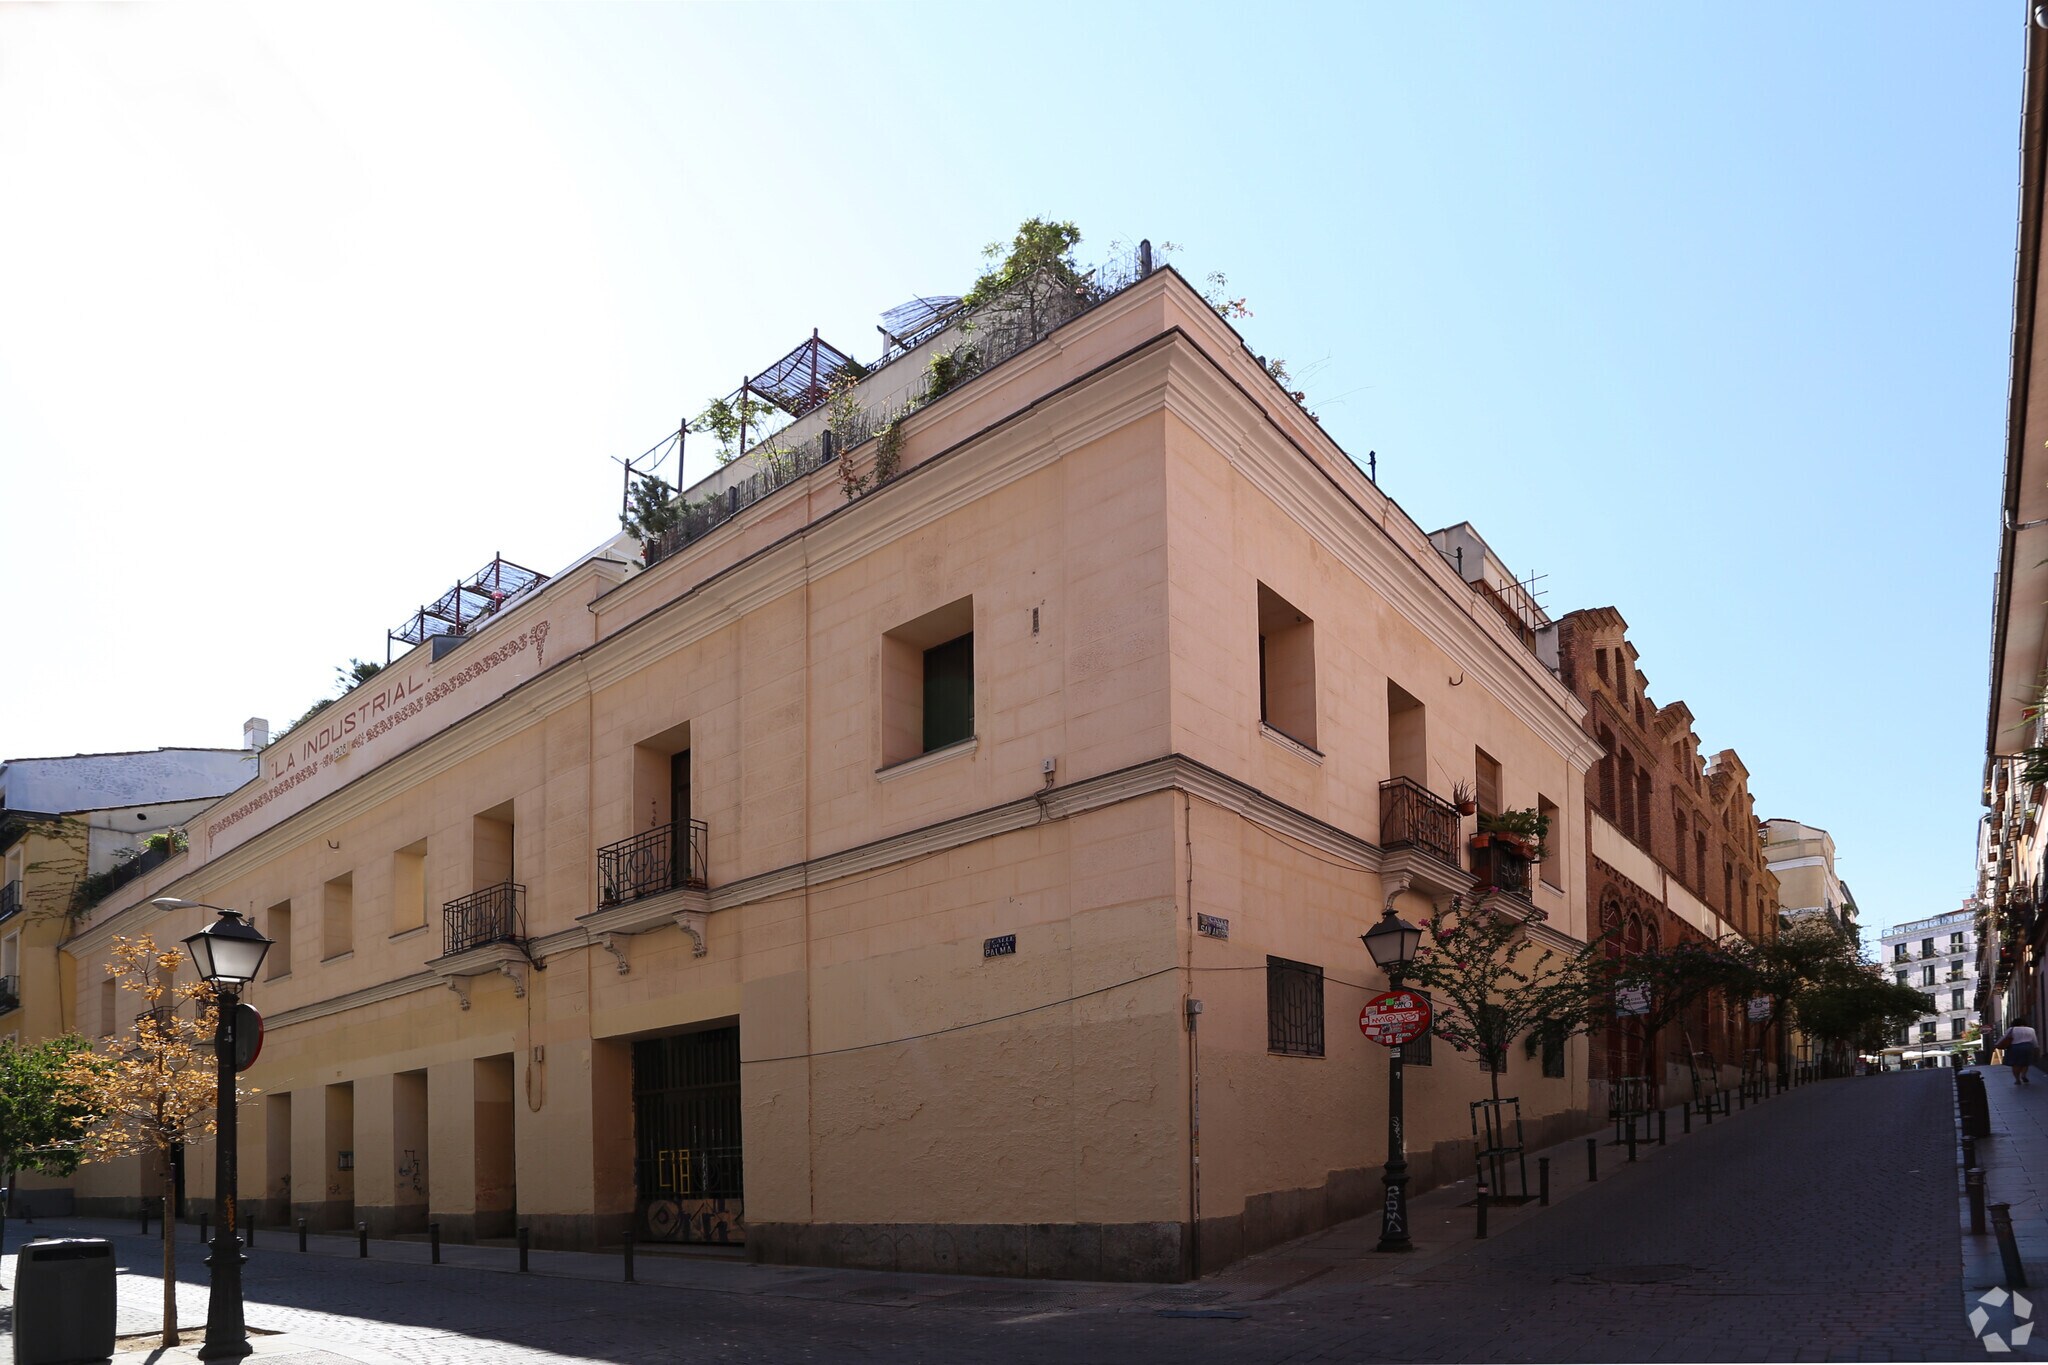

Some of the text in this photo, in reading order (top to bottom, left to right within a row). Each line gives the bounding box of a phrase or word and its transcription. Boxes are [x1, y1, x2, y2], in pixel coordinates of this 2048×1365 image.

[275, 675, 423, 778] LA INDUSTRIAL
[985, 946, 1012, 956] PALMA
